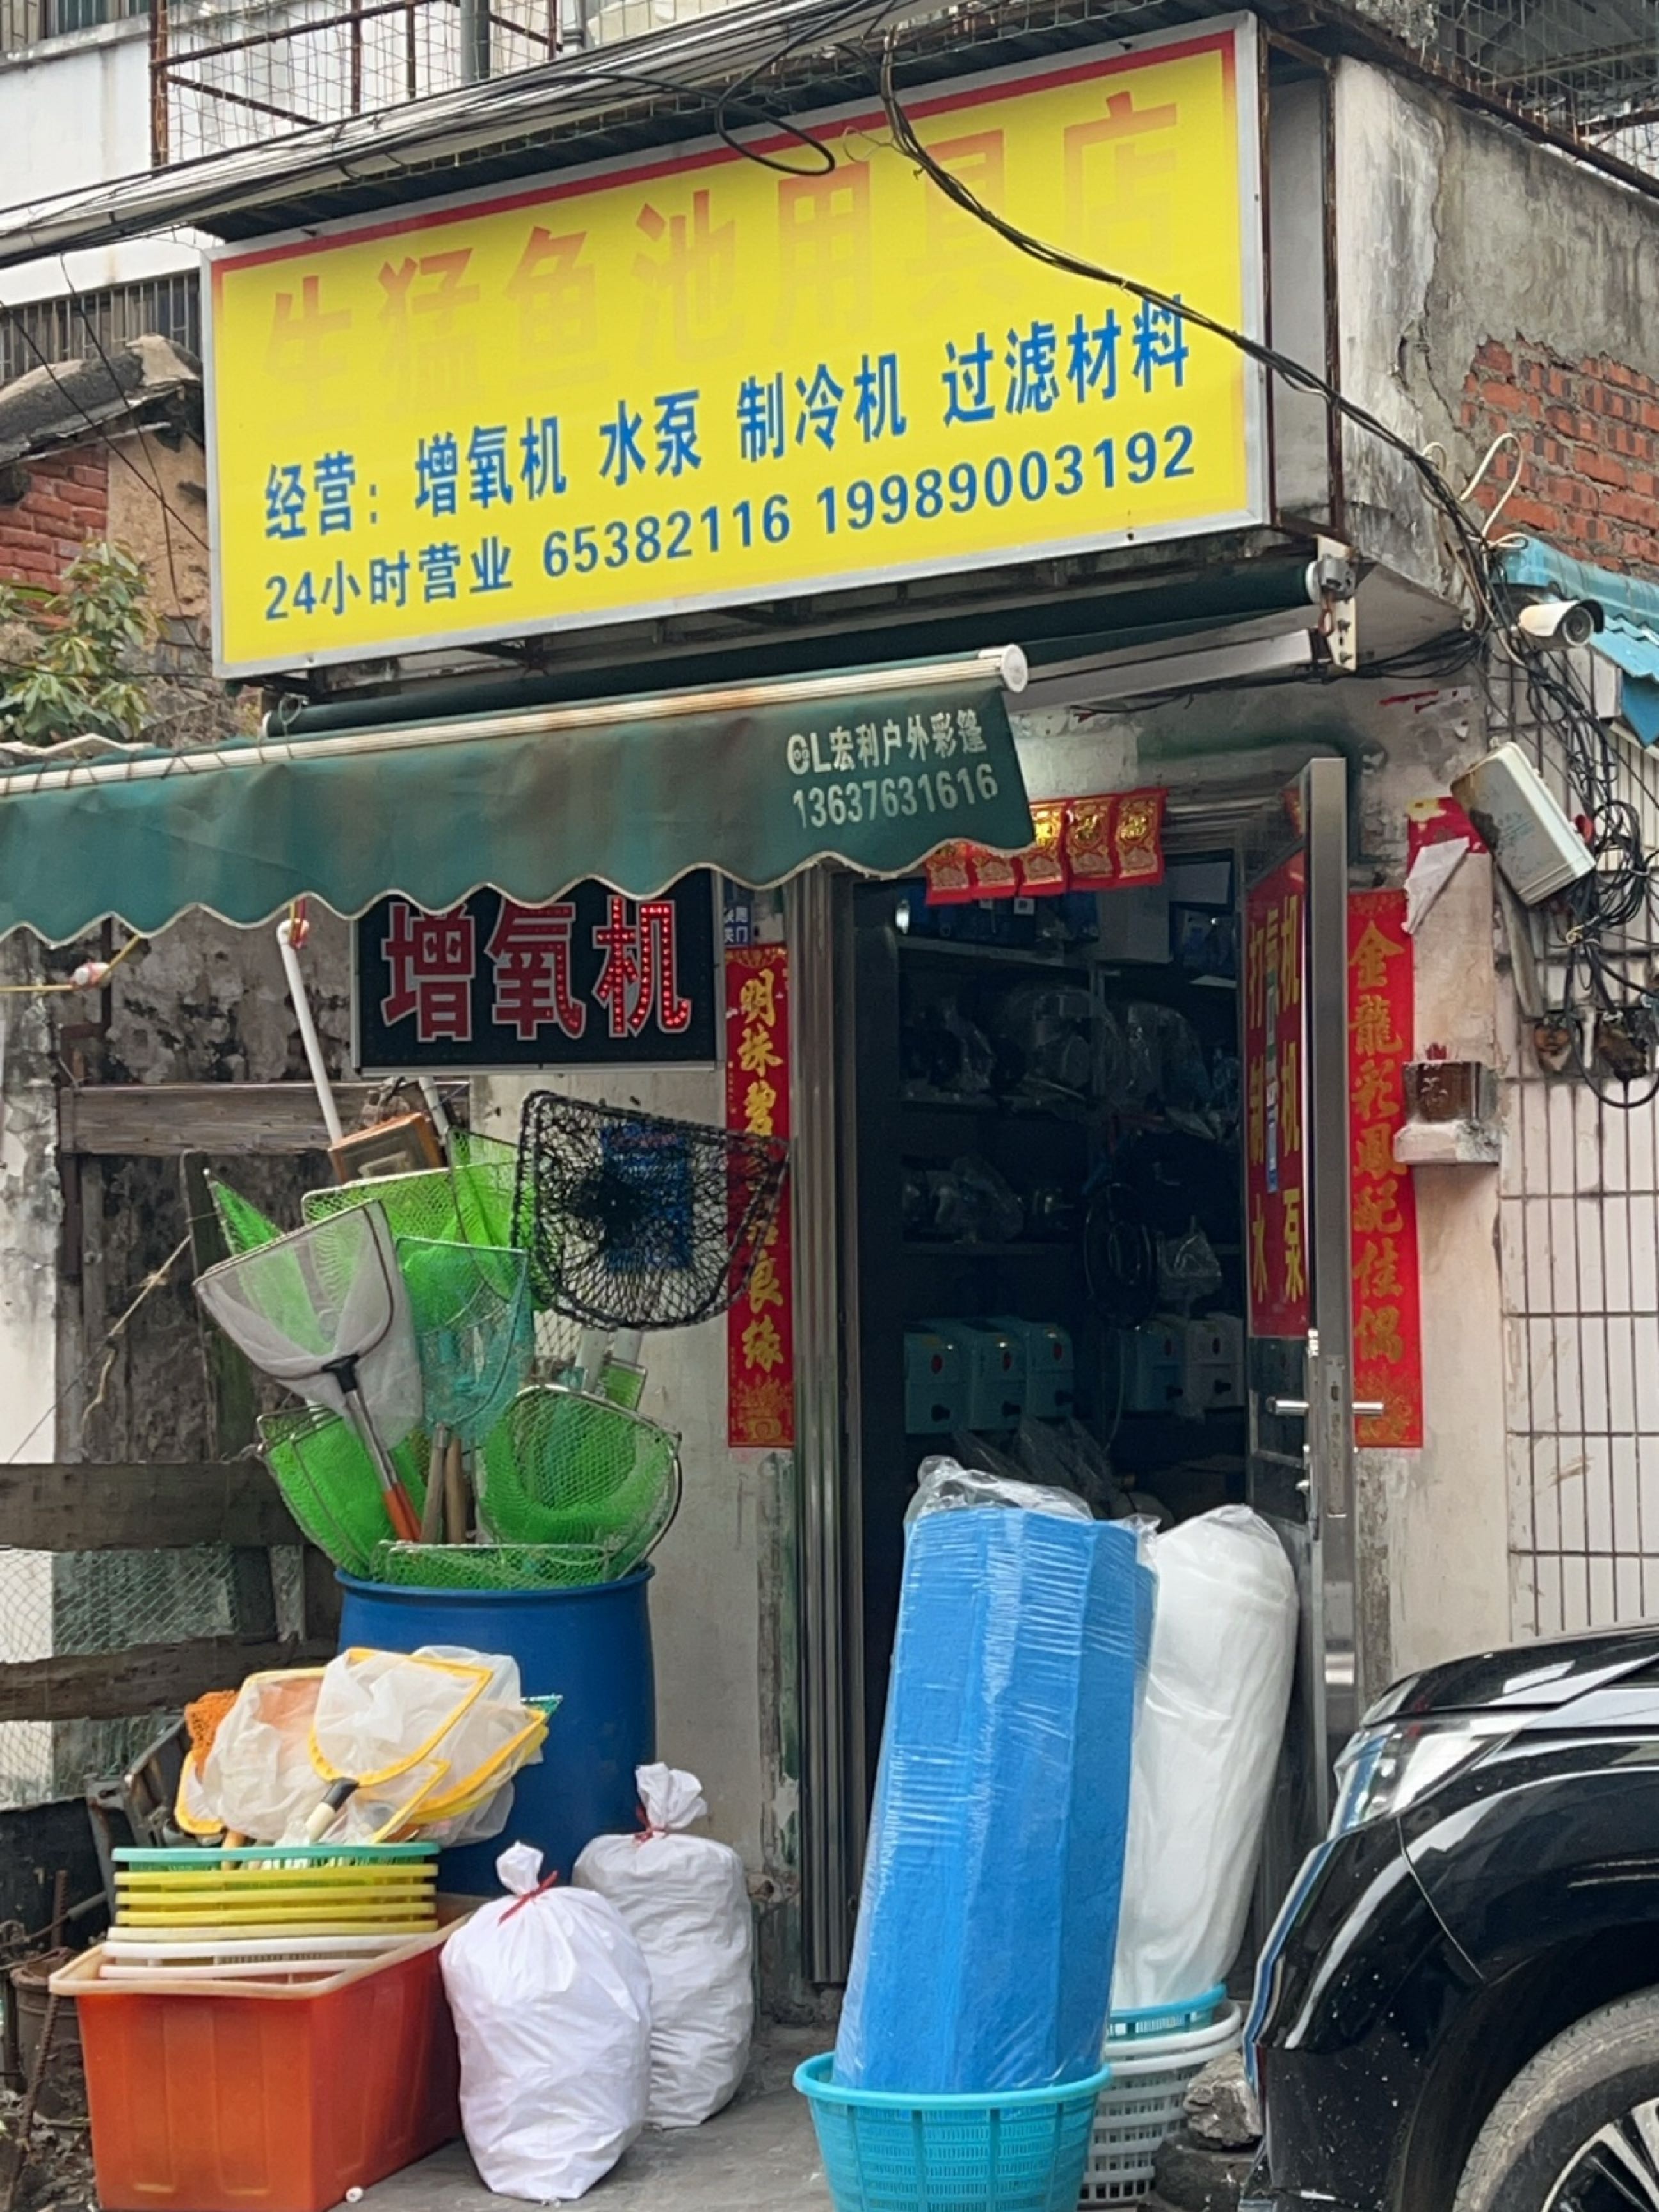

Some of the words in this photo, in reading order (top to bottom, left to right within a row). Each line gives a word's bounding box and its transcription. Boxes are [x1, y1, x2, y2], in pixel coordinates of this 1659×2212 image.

[262, 91, 1178, 434] 生猛鱼池用具店
[415, 415, 567, 517] 增氧机
[600, 389, 702, 486] 水泵
[737, 352, 908, 461] 制冷机
[941, 294, 1189, 428] 过滤材料
[265, 536, 513, 621] 24小时营业
[543, 494, 792, 577] 65382116
[817, 424, 1194, 534] 19989003192
[792, 762, 998, 830] 13637631616
[381, 895, 691, 1042] 增氧机
